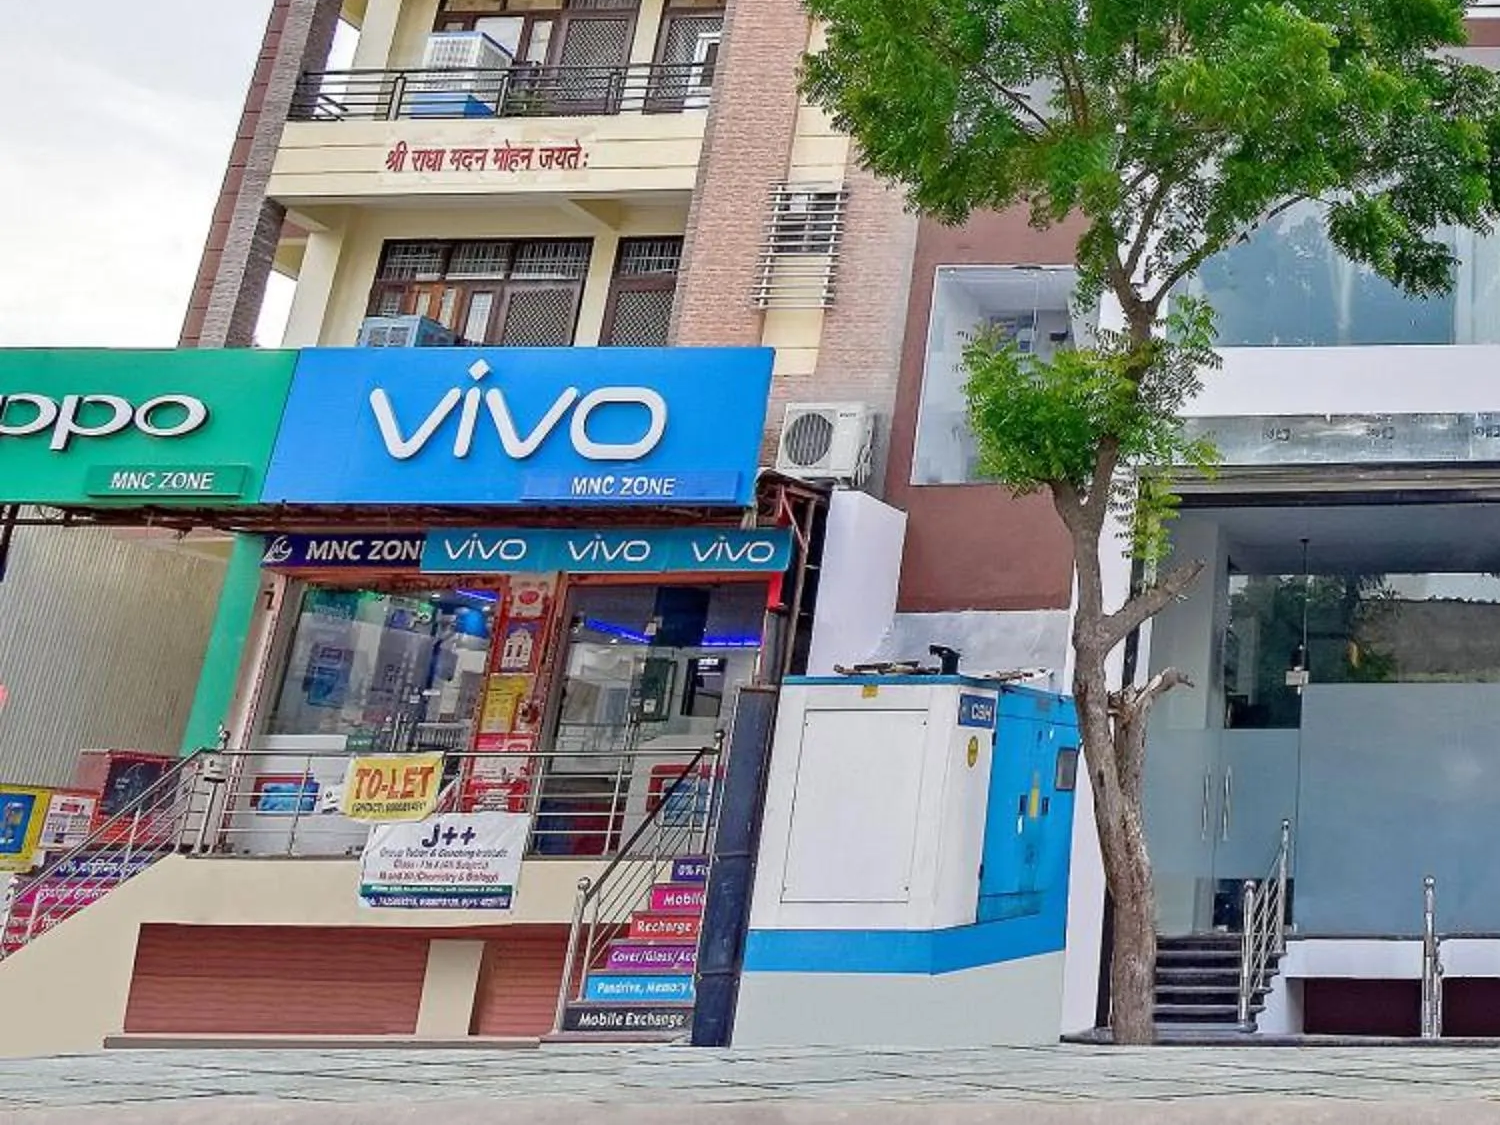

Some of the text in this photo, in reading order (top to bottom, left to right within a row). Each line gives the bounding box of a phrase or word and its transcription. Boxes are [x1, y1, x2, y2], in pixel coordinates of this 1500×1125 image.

[385, 139, 407, 172] श्री
[412, 148, 444, 172] राधा
[450, 148, 488, 172] मदन
[493, 139, 534, 172] मोहन
[0, 392, 207, 451] ppo
[369, 358, 667, 460] vivo
[110, 472, 214, 490] MNC ZONE
[571, 476, 676, 496] MNC ZONE
[305, 540, 362, 561] MNC
[367, 540, 426, 561] ZON
[444, 532, 527, 561] vivo
[567, 533, 651, 562] vivo
[691, 535, 775, 563] vivo
[355, 766, 434, 800] TO-LET
[422, 824, 476, 848] J++
[638, 920, 692, 935] Recharge
[578, 1012, 685, 1028] Mobile Exchange
